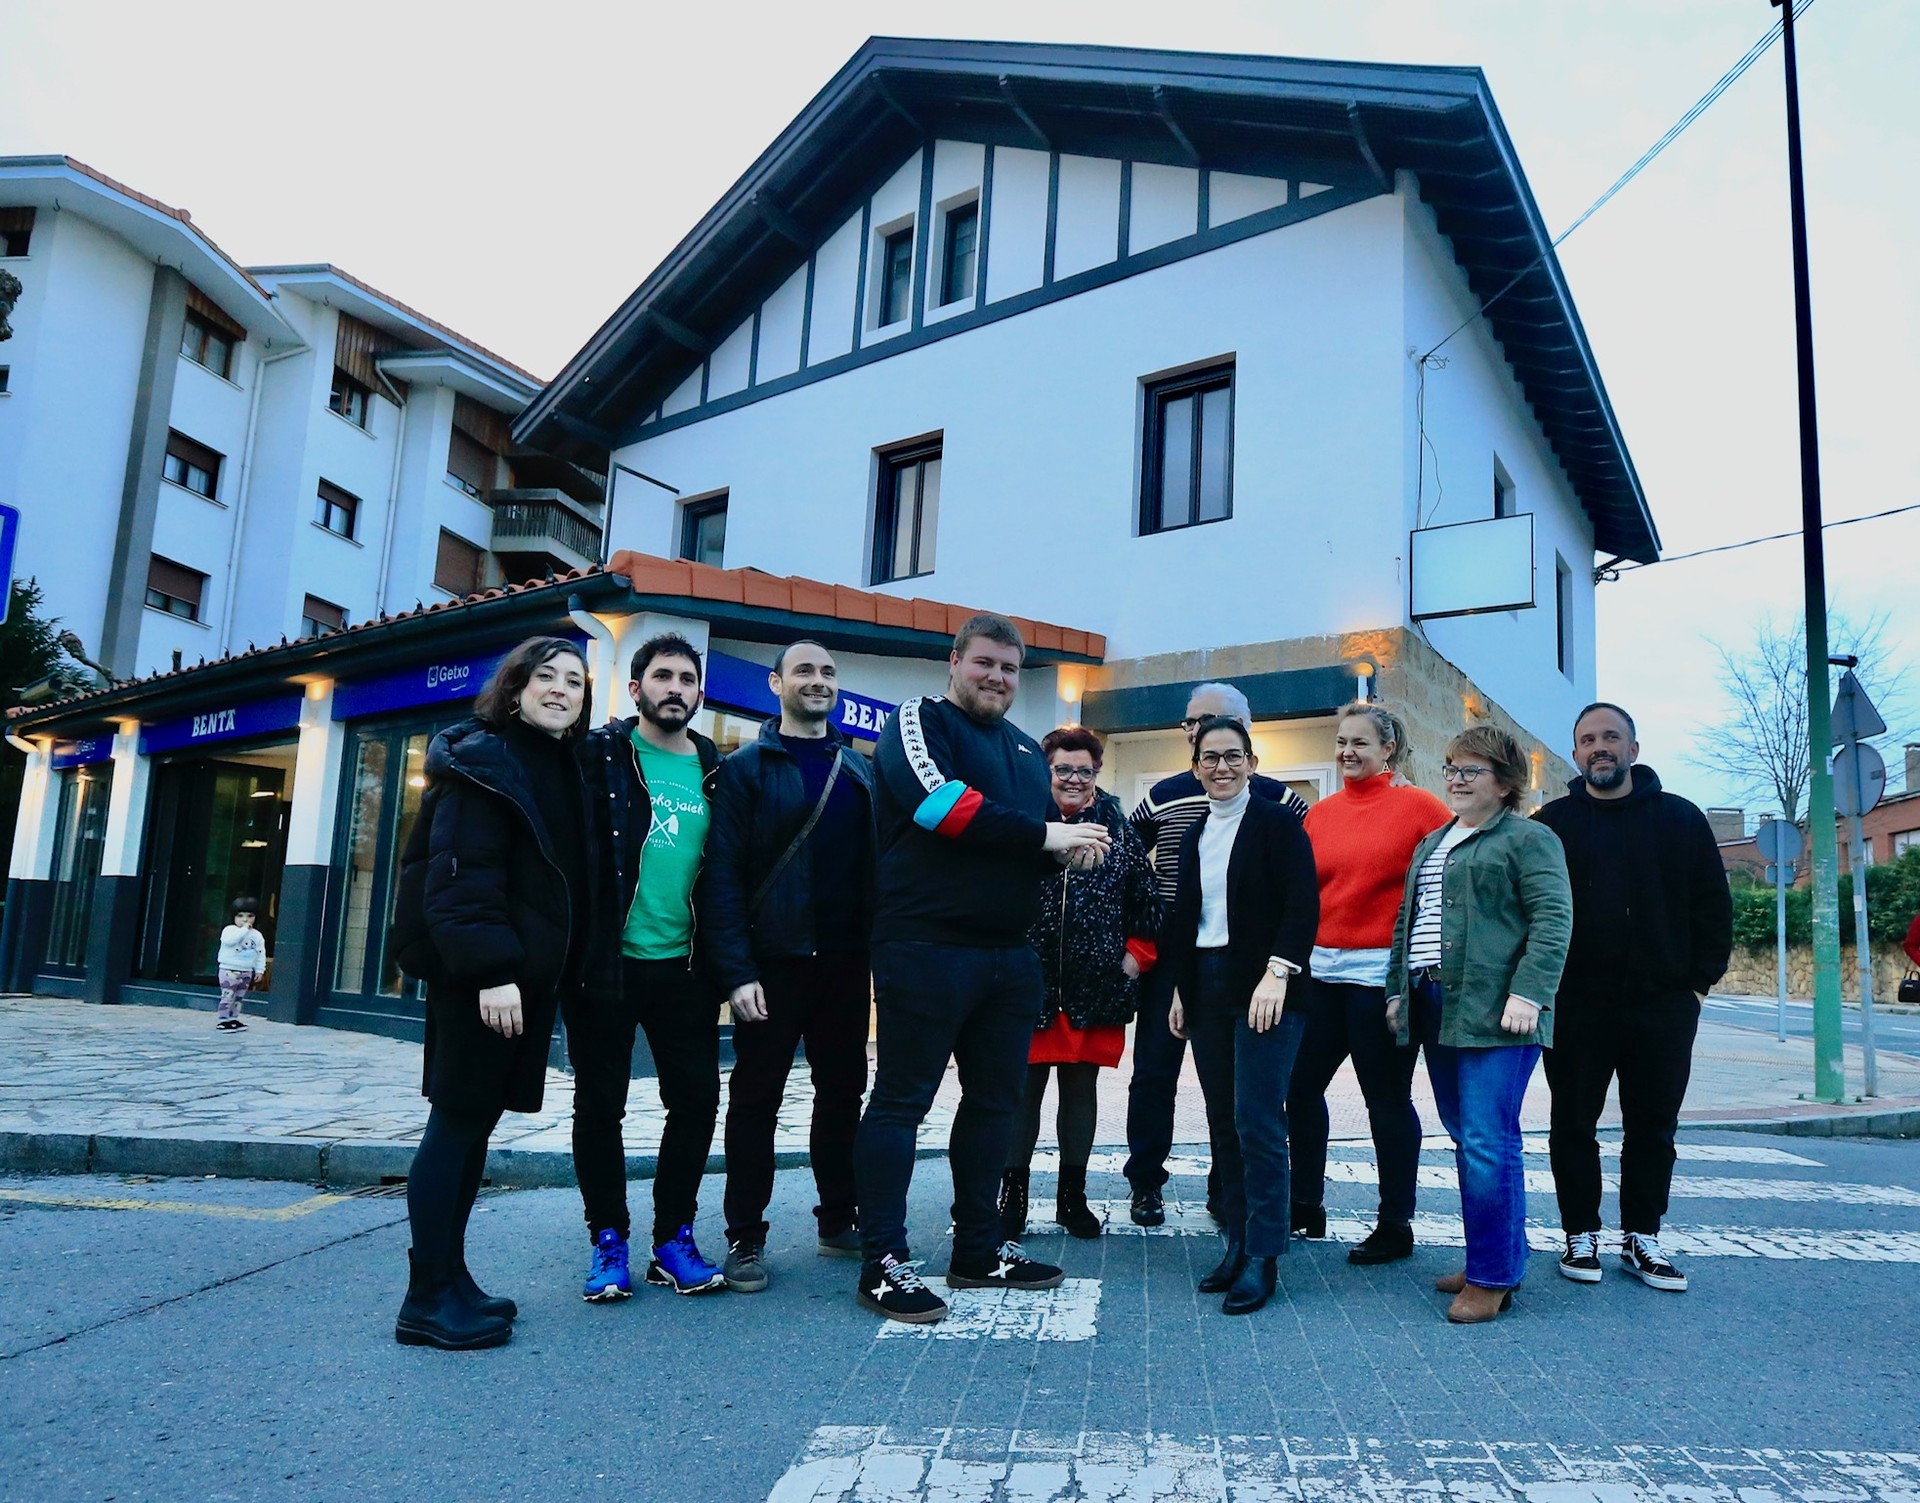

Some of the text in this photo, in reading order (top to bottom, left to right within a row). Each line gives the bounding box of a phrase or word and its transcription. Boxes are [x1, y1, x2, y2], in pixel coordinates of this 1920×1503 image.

[440, 665, 469, 682] Getxo
[191, 709, 236, 737] BENTA
[841, 698, 890, 733] BEN
